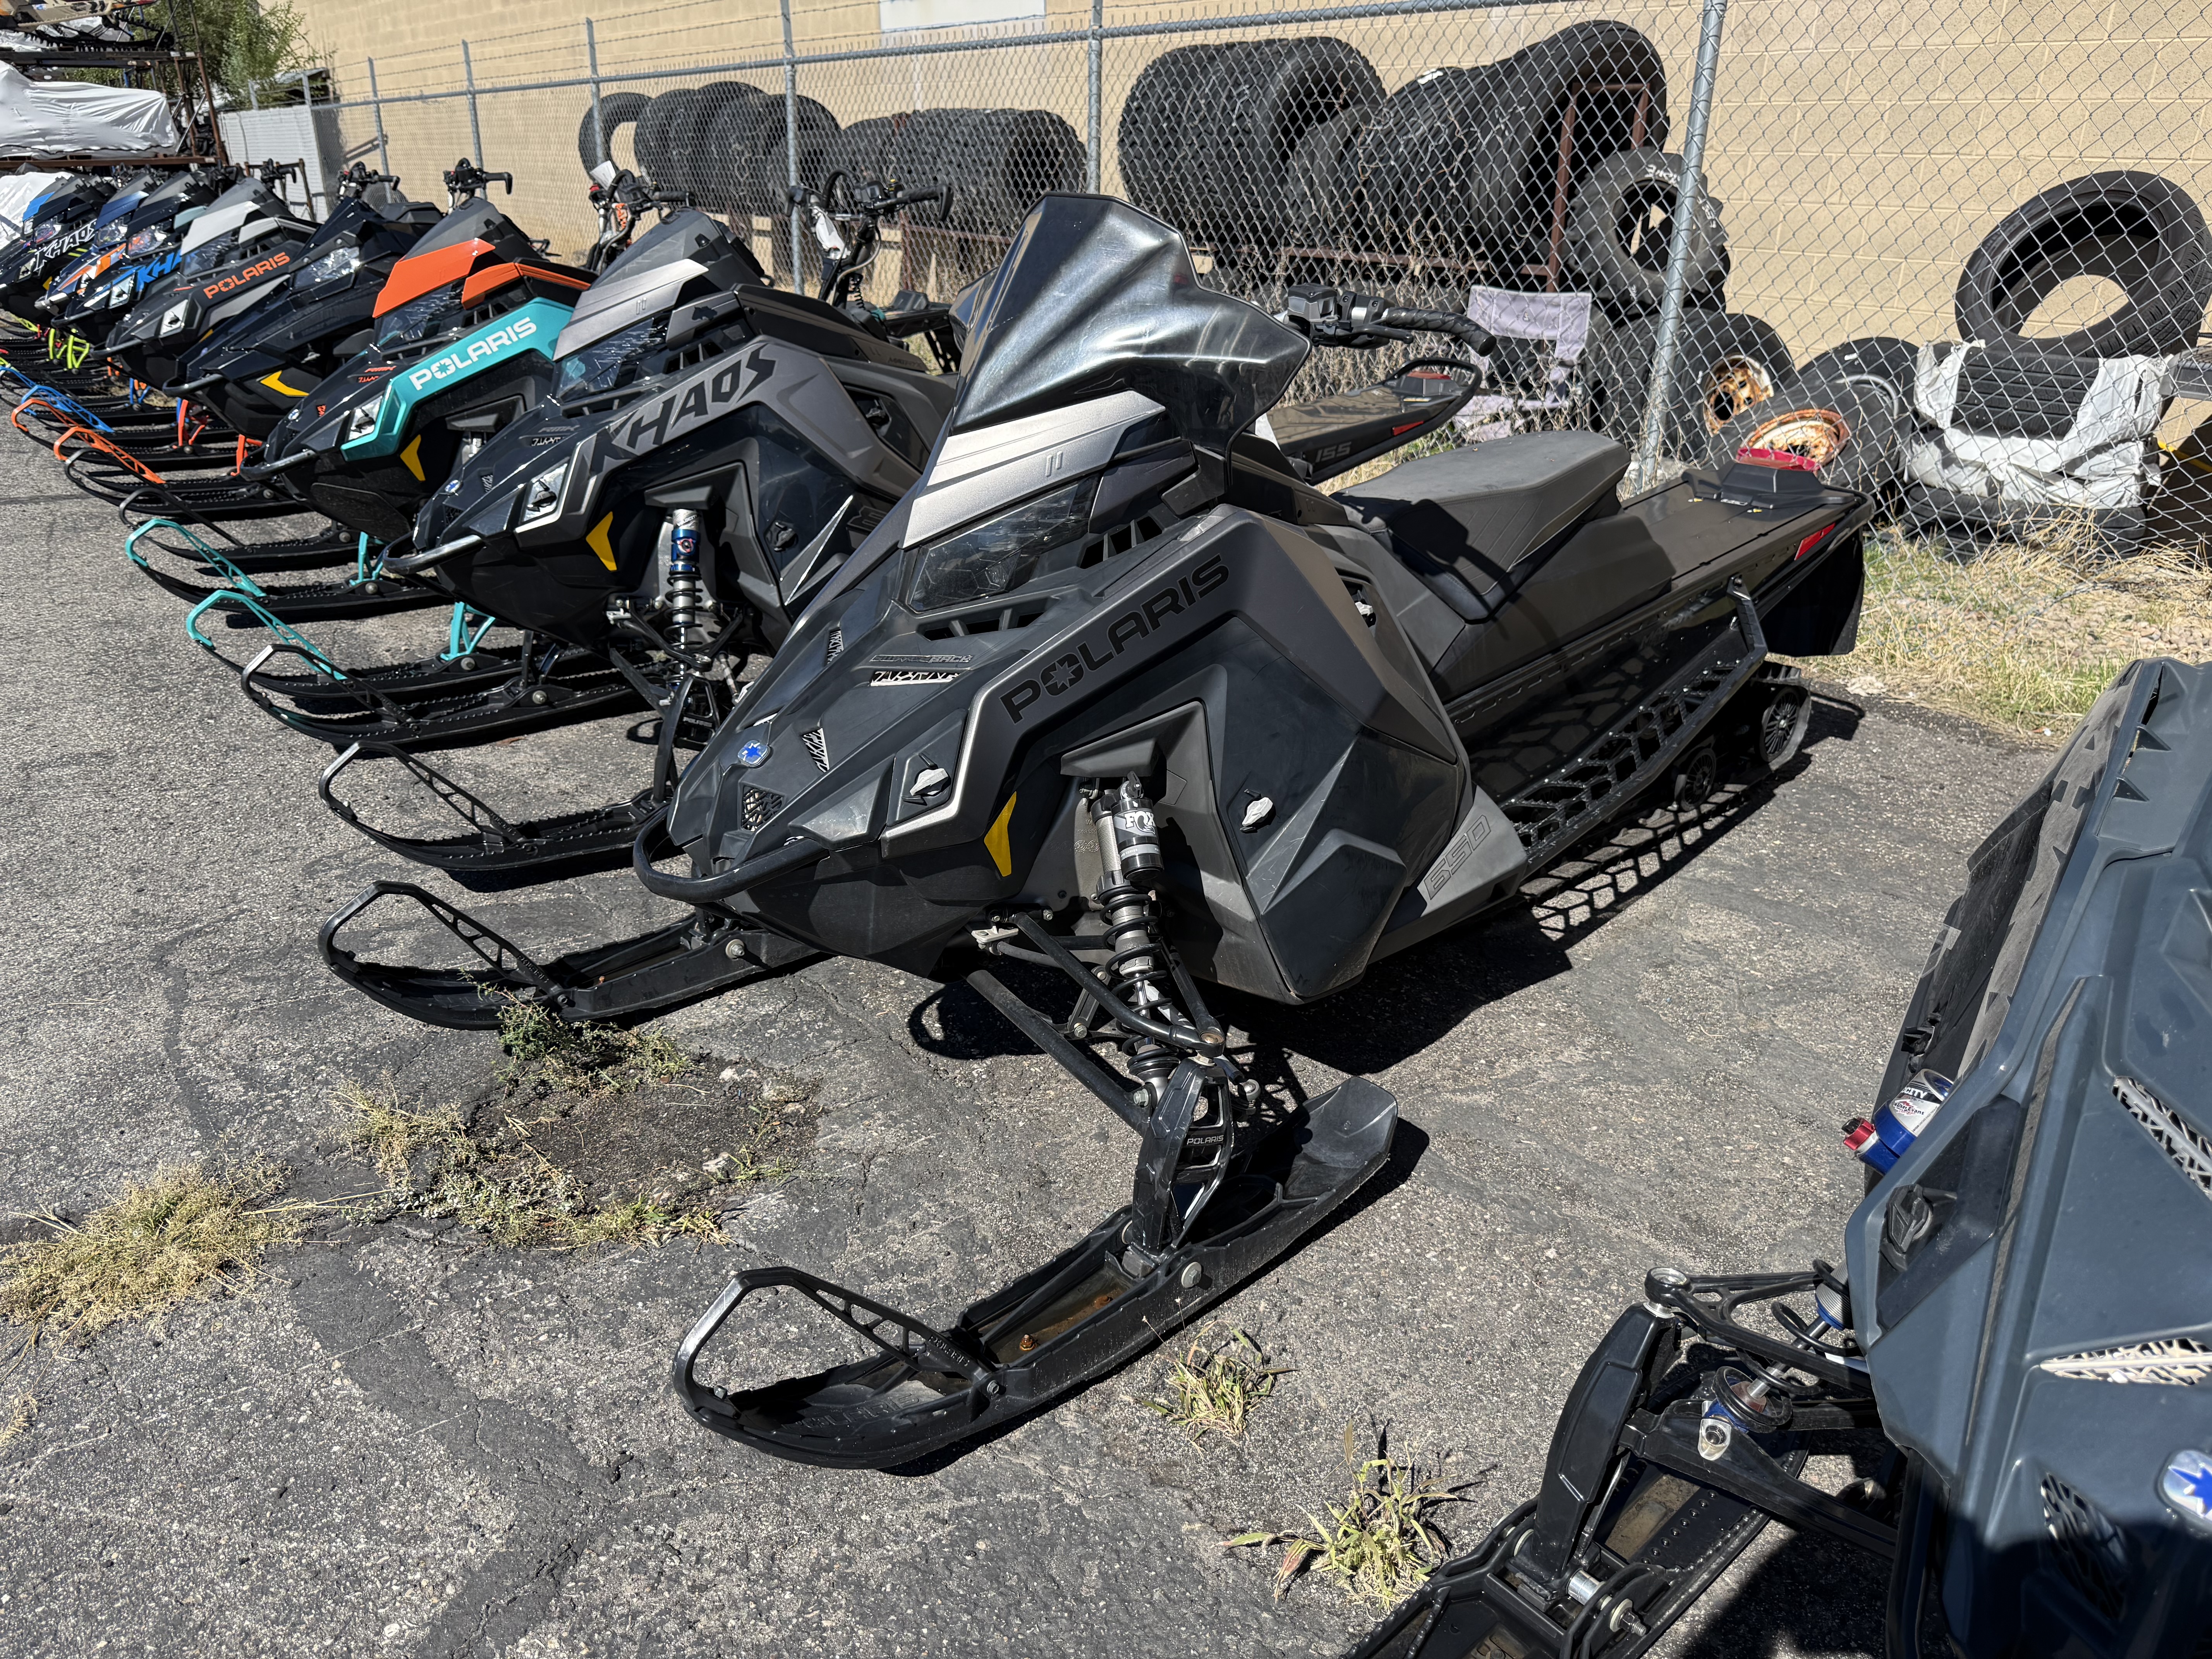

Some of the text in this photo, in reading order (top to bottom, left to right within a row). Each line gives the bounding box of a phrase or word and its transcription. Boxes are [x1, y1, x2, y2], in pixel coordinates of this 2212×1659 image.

[204, 252, 290, 299] POLARIS
[409, 317, 537, 391] POLARIS
[588, 343, 776, 474] KHAOS
[1315, 441, 1352, 463] 155
[998, 553, 1230, 725] POLARIS
[1124, 810, 1157, 835] FOX
[1424, 814, 1491, 900] 650
[1186, 1135, 1224, 1145] POLARIS
[929, 1335, 970, 1367] POLARIS
